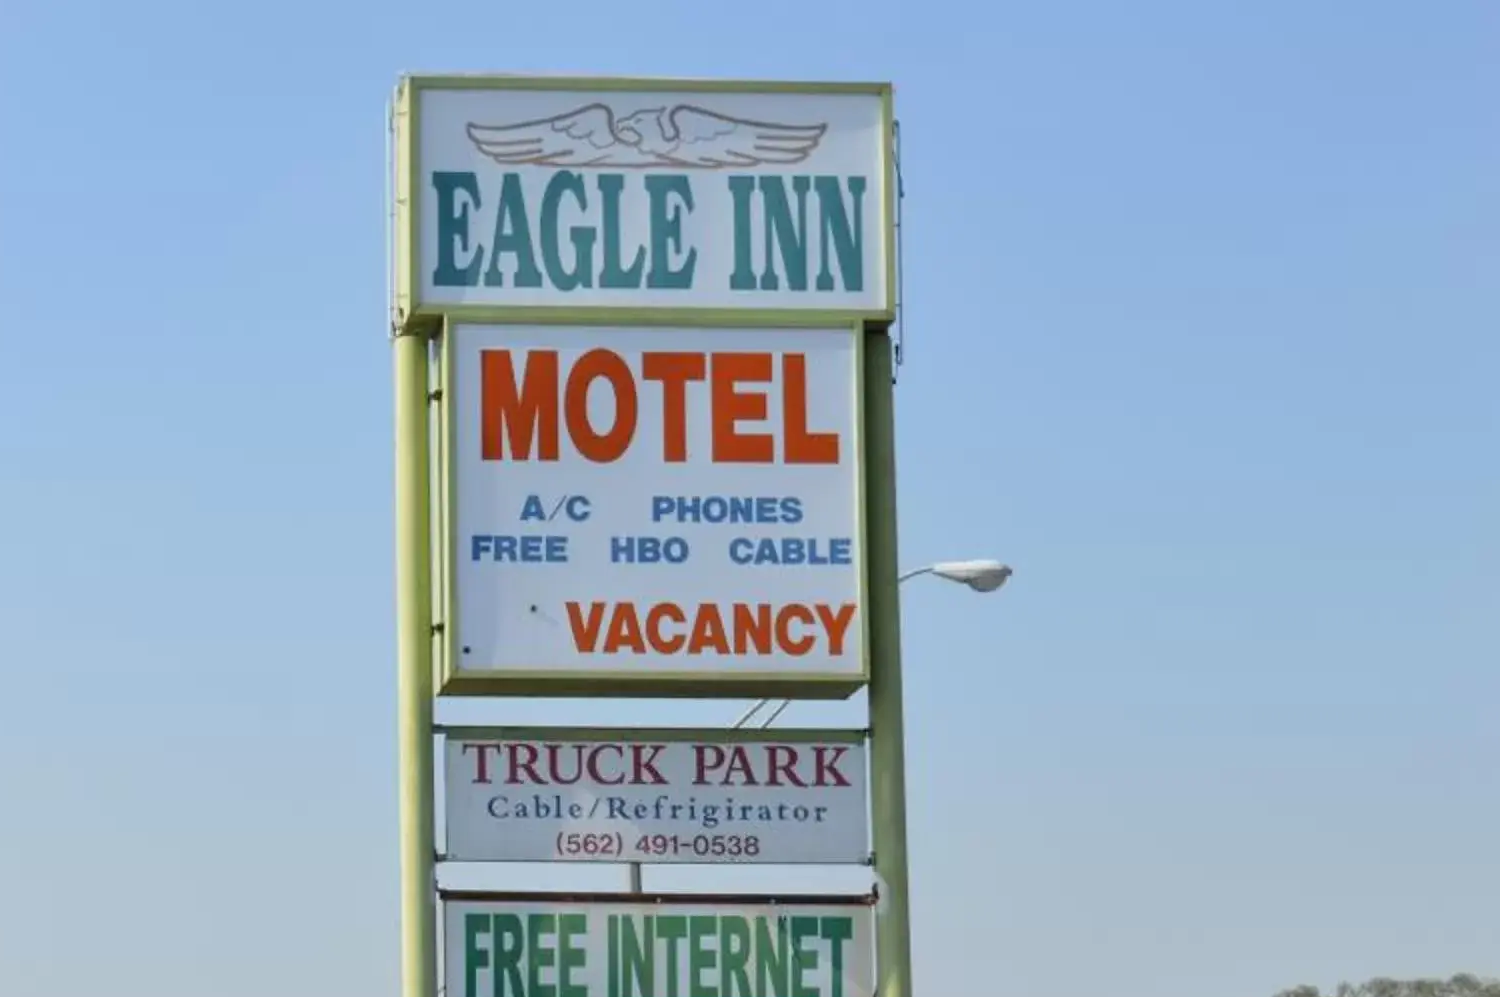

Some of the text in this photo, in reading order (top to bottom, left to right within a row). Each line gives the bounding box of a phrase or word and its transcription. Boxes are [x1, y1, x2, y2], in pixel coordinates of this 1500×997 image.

[431, 170, 867, 292] EAGLE INN
[480, 347, 840, 464] MOTEL
[520, 495, 803, 523] A/C PHONES
[471, 535, 852, 565] FREE HBO CABLE
[565, 601, 857, 657] VACANCY
[462, 743, 852, 787] TRUCK PARK
[487, 795, 829, 828] Cable/Refrigirator
[555, 831, 760, 857] (562) 491-0538
